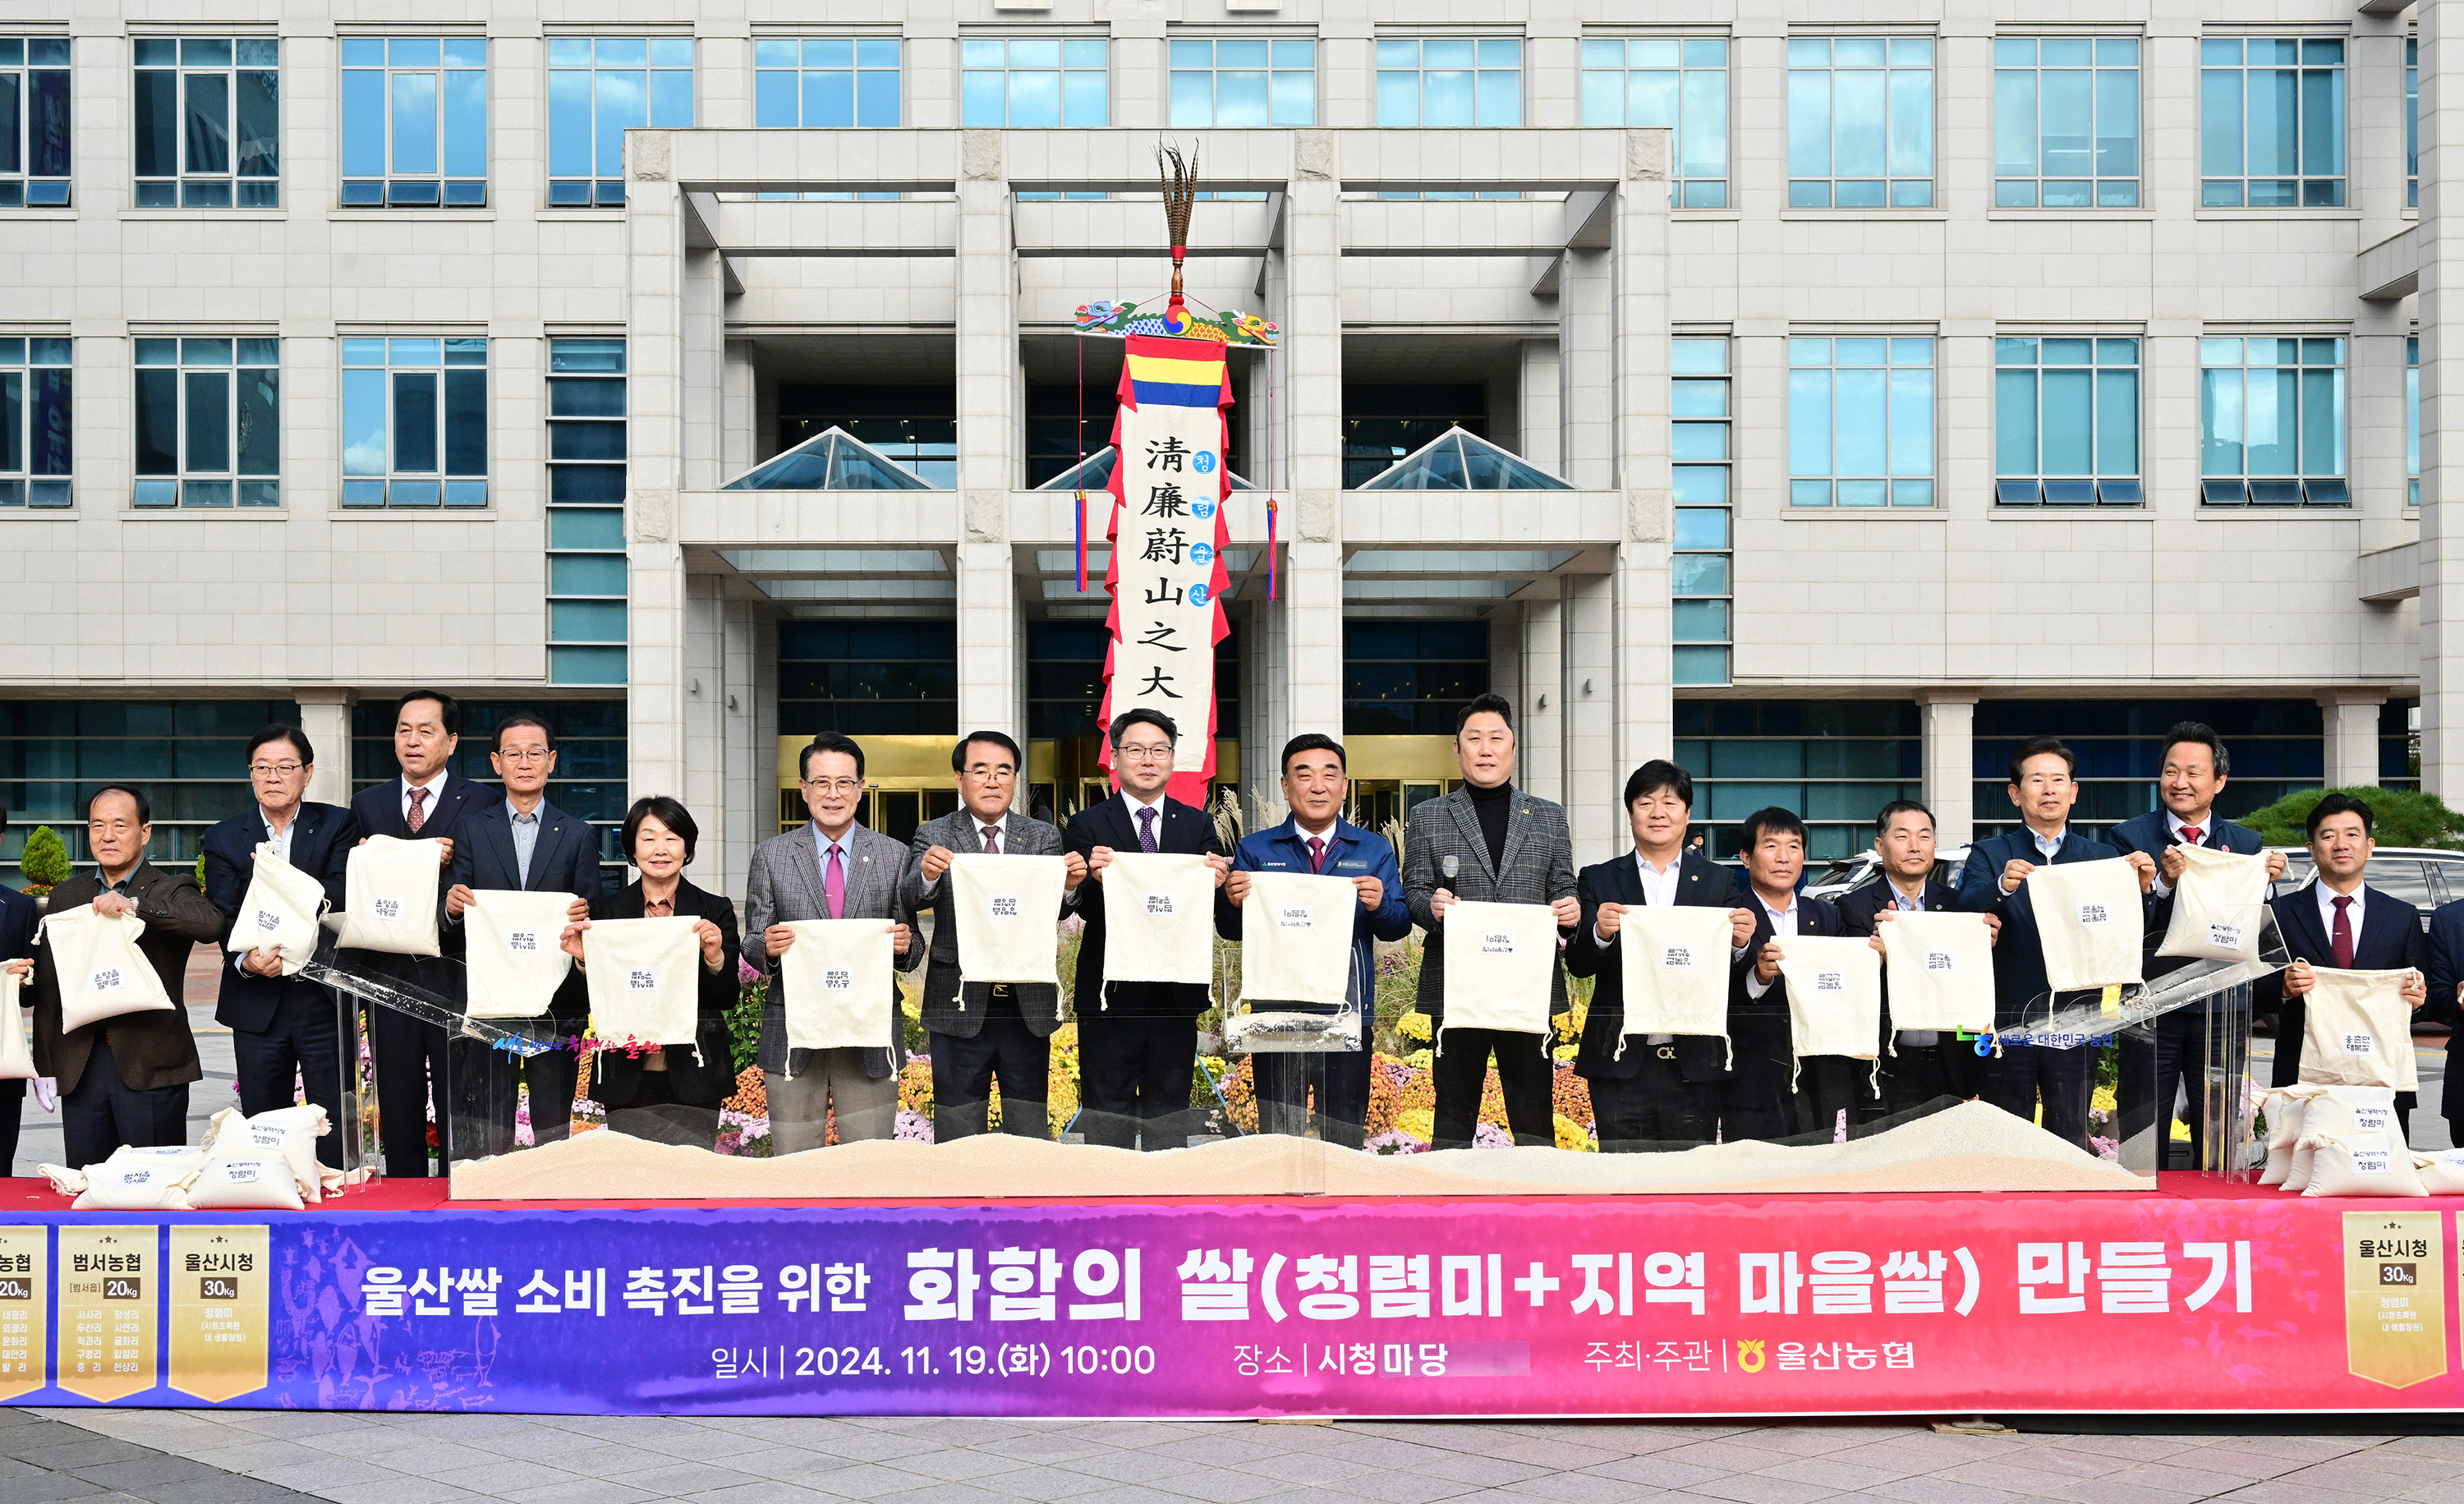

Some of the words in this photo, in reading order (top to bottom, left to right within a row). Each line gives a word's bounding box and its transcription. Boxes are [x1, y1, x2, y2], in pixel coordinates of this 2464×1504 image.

[375, 899, 398, 909] 온양읍
[1147, 904, 1173, 913] 범서읍
[258, 910, 280, 924] 범서읍
[2212, 933, 2237, 945] 청렴미
[511, 941, 536, 950] 범서읍
[94, 968, 120, 982] 온양읍
[630, 980, 655, 988] 범서읍
[825, 980, 849, 988] 온양읍
[1997, 1033, 2034, 1047] 새로운
[2038, 1033, 2086, 1047] 대한민국
[2089, 1033, 2113, 1047] 농협
[2345, 1035, 2370, 1044] 웅촌면
[493, 1032, 528, 1065] 새로
[566, 1034, 618, 1061] 위대한
[621, 1033, 662, 1060] 울산
[2359, 1118, 2384, 1129] 청렴미
[252, 1134, 280, 1147] 청렴미
[2357, 1161, 2386, 1171] 청렴미
[228, 1169, 256, 1180] 청렴미
[2359, 1239, 2428, 1258] 울산시청
[73, 1253, 141, 1272] 범서농협
[184, 1253, 254, 1272] 울산시청
[2383, 1266, 2414, 1283] 30Kg
[361, 1266, 503, 1318] 울산쌀
[515, 1267, 607, 1317] 소비
[623, 1264, 764, 1316] 촉진을
[777, 1262, 871, 1314] 위한
[903, 1245, 1142, 1322] 화합의
[1175, 1247, 1706, 1323] 쌀(청렴미+지역
[1738, 1245, 1981, 1318] 마을쌀)
[2016, 1240, 2253, 1314] 만들기
[69, 1282, 101, 1294] [범서읍]
[107, 1280, 138, 1298] 20Kg
[204, 1280, 235, 1297] 30Kg
[2380, 1297, 2409, 1309] 청렴미
[2, 1309, 28, 1320] 내광리
[76, 1309, 102, 1320] 서사리
[113, 1309, 140, 1320] 망성리
[205, 1307, 233, 1319] 청렴미
[2, 1322, 27, 1333] 외광리
[76, 1322, 102, 1333] 두산리
[113, 1322, 140, 1333] 사연리
[201, 1320, 241, 1332] (시청초록원
[2382, 1322, 2389, 1332] 내
[2, 1336, 27, 1346] 운화리
[76, 1336, 102, 1346] 척과리
[113, 1336, 139, 1346] 굴화리
[205, 1332, 213, 1343] 내
[214, 1332, 246, 1343] 생활정원)
[2, 1349, 27, 1359] 대안리
[76, 1349, 102, 1359] 구영리
[113, 1349, 139, 1359] 입암리
[1233, 1343, 1294, 1377] 장소
[1317, 1341, 1449, 1378] 시청마당
[1584, 1340, 1712, 1373] 주최·주관
[1776, 1340, 1915, 1371] 울산농협
[711, 1346, 768, 1379] 일시
[794, 1345, 892, 1377] 2024.
[900, 1345, 940, 1376] 11.
[949, 1341, 1050, 1379] 19.(화)
[1060, 1345, 1156, 1375] 10:00
[113, 1362, 139, 1373] 천상리
